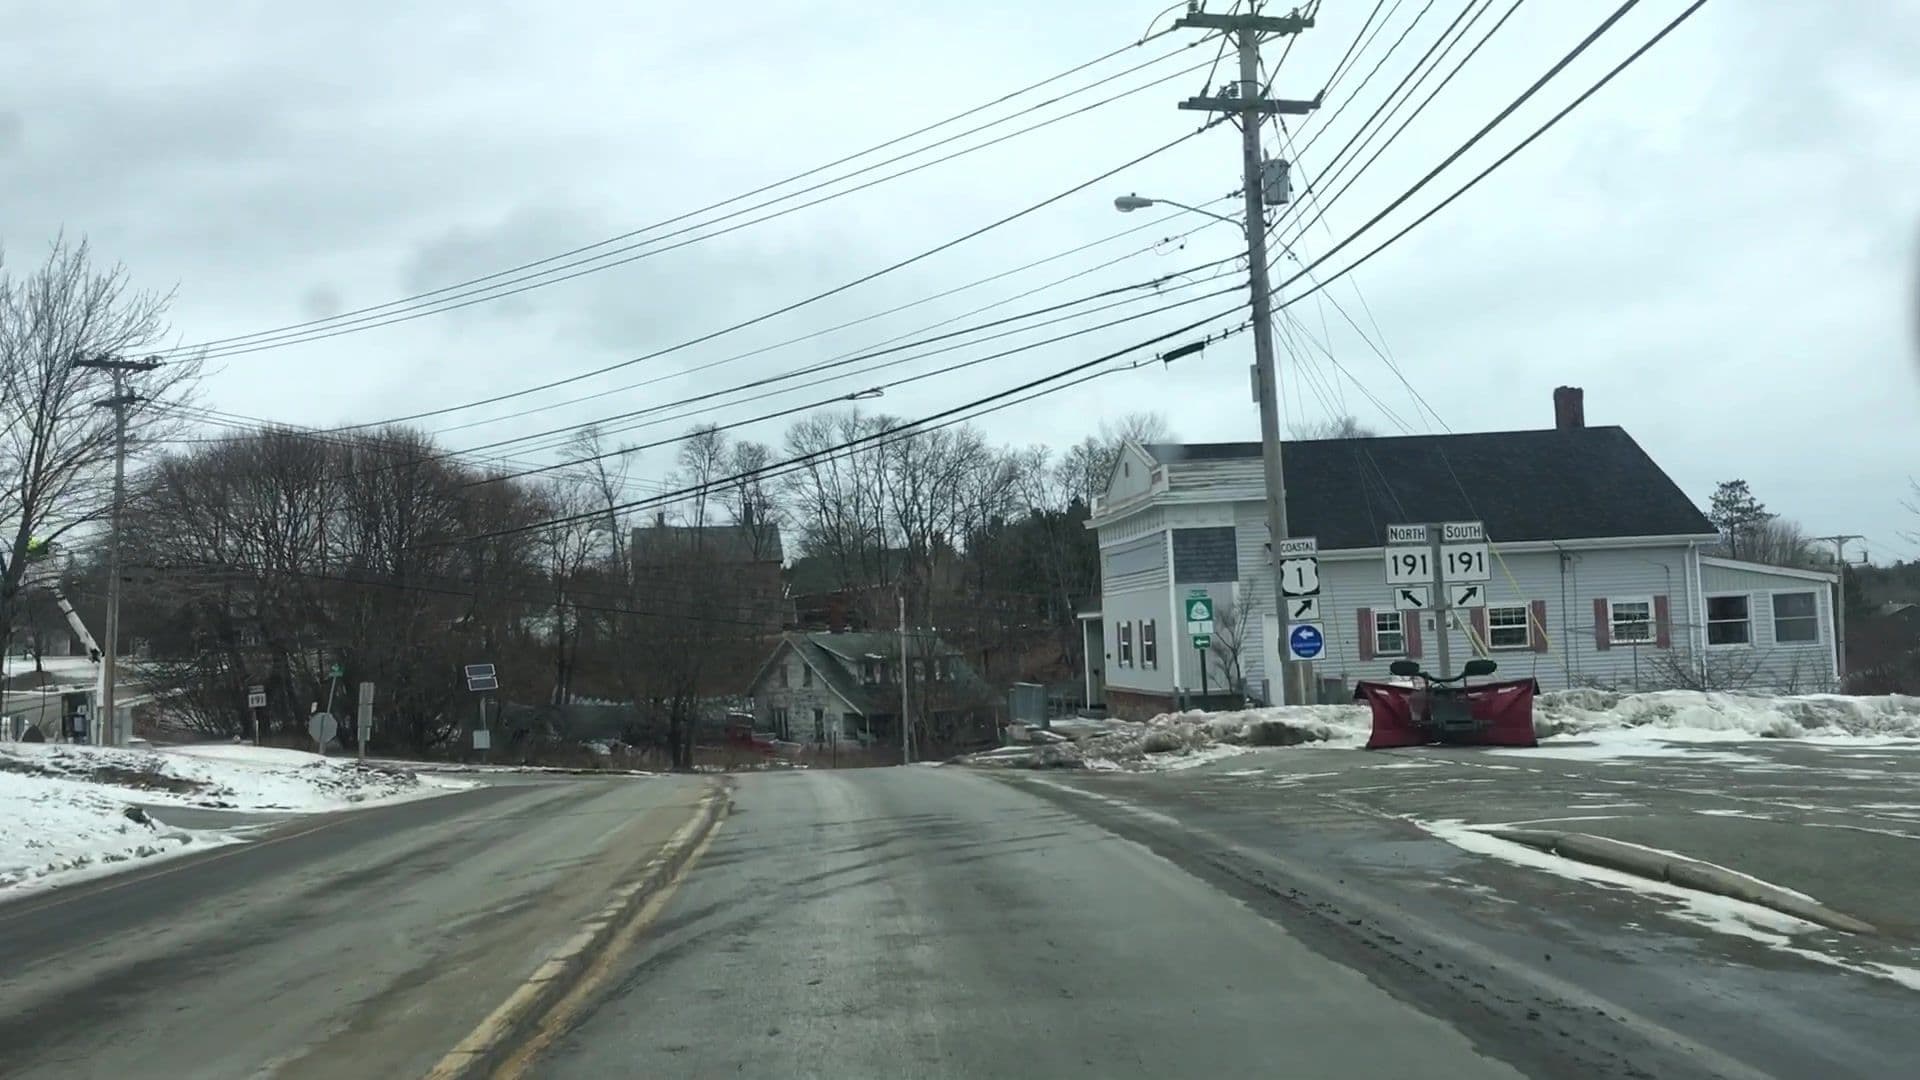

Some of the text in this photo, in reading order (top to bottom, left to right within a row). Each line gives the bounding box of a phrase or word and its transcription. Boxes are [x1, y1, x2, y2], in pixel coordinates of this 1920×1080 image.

[1390, 527, 1425, 540] NORTH
[1446, 526, 1481, 538] SOUTH
[1281, 543, 1315, 553] COASTAL
[1392, 554, 1428, 576] 191
[1448, 551, 1483, 574] 191
[1296, 567, 1303, 587] 1
